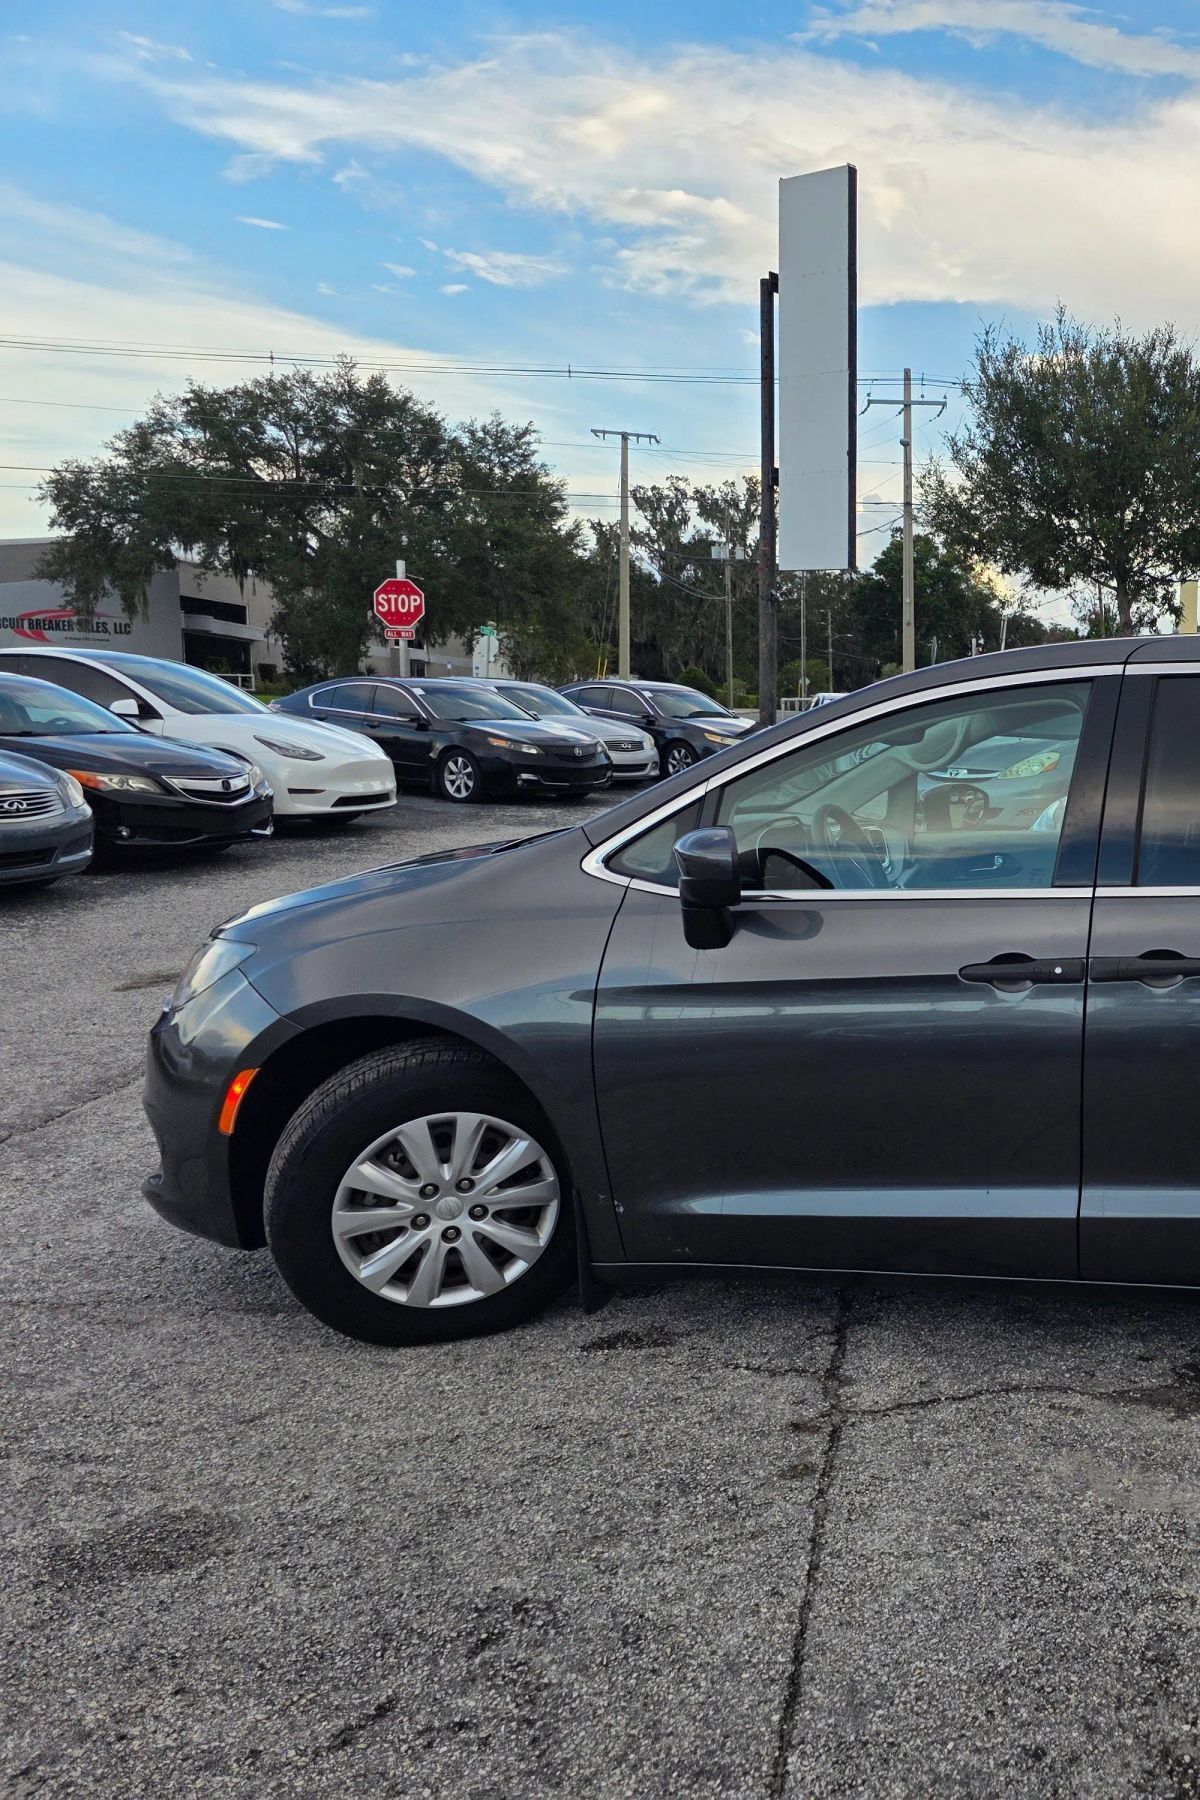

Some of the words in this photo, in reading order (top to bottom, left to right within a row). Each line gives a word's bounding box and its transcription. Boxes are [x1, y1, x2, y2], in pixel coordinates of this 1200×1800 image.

[378, 594, 421, 613] STOP
[0, 617, 25, 629] CUIT
[28, 618, 74, 632] BREAKER
[114, 622, 132, 636] LLC
